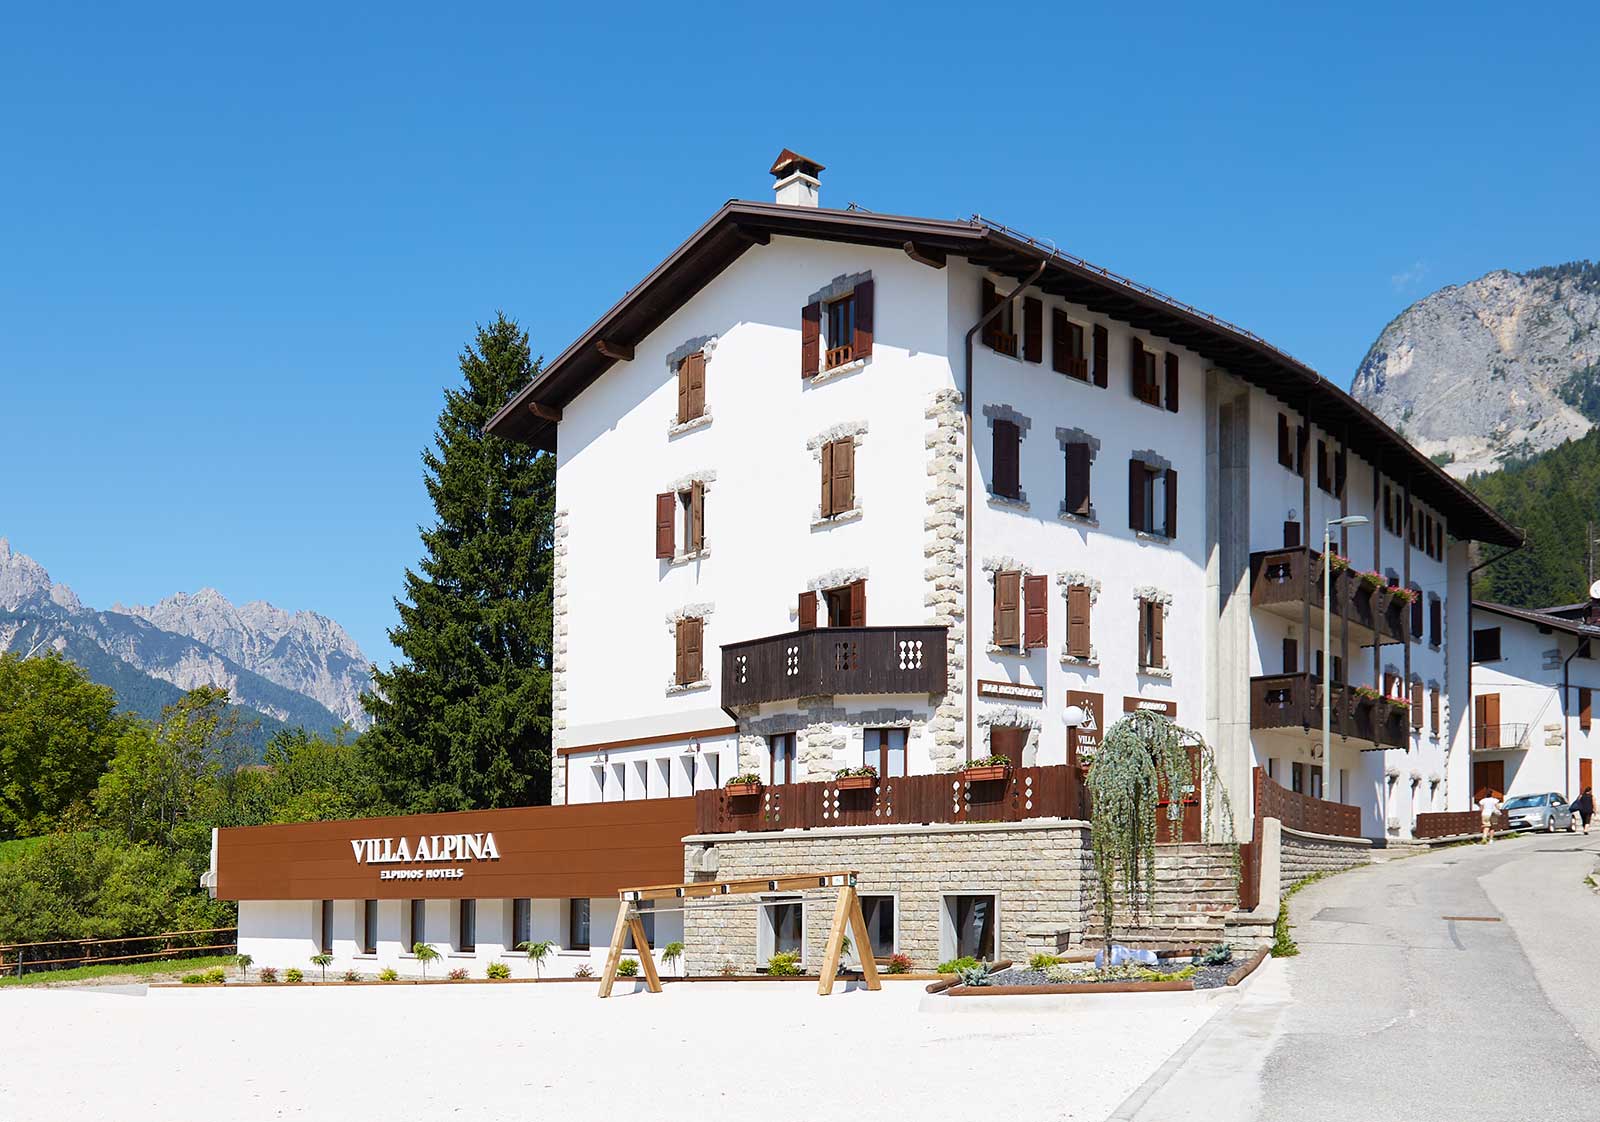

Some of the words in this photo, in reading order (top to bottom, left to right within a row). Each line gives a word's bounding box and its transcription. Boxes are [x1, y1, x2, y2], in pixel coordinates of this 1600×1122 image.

[1078, 734, 1096, 745] VILLA
[351, 837, 412, 863] VILLA
[413, 832, 500, 861] ALPINA
[425, 868, 464, 879] HOTELS
